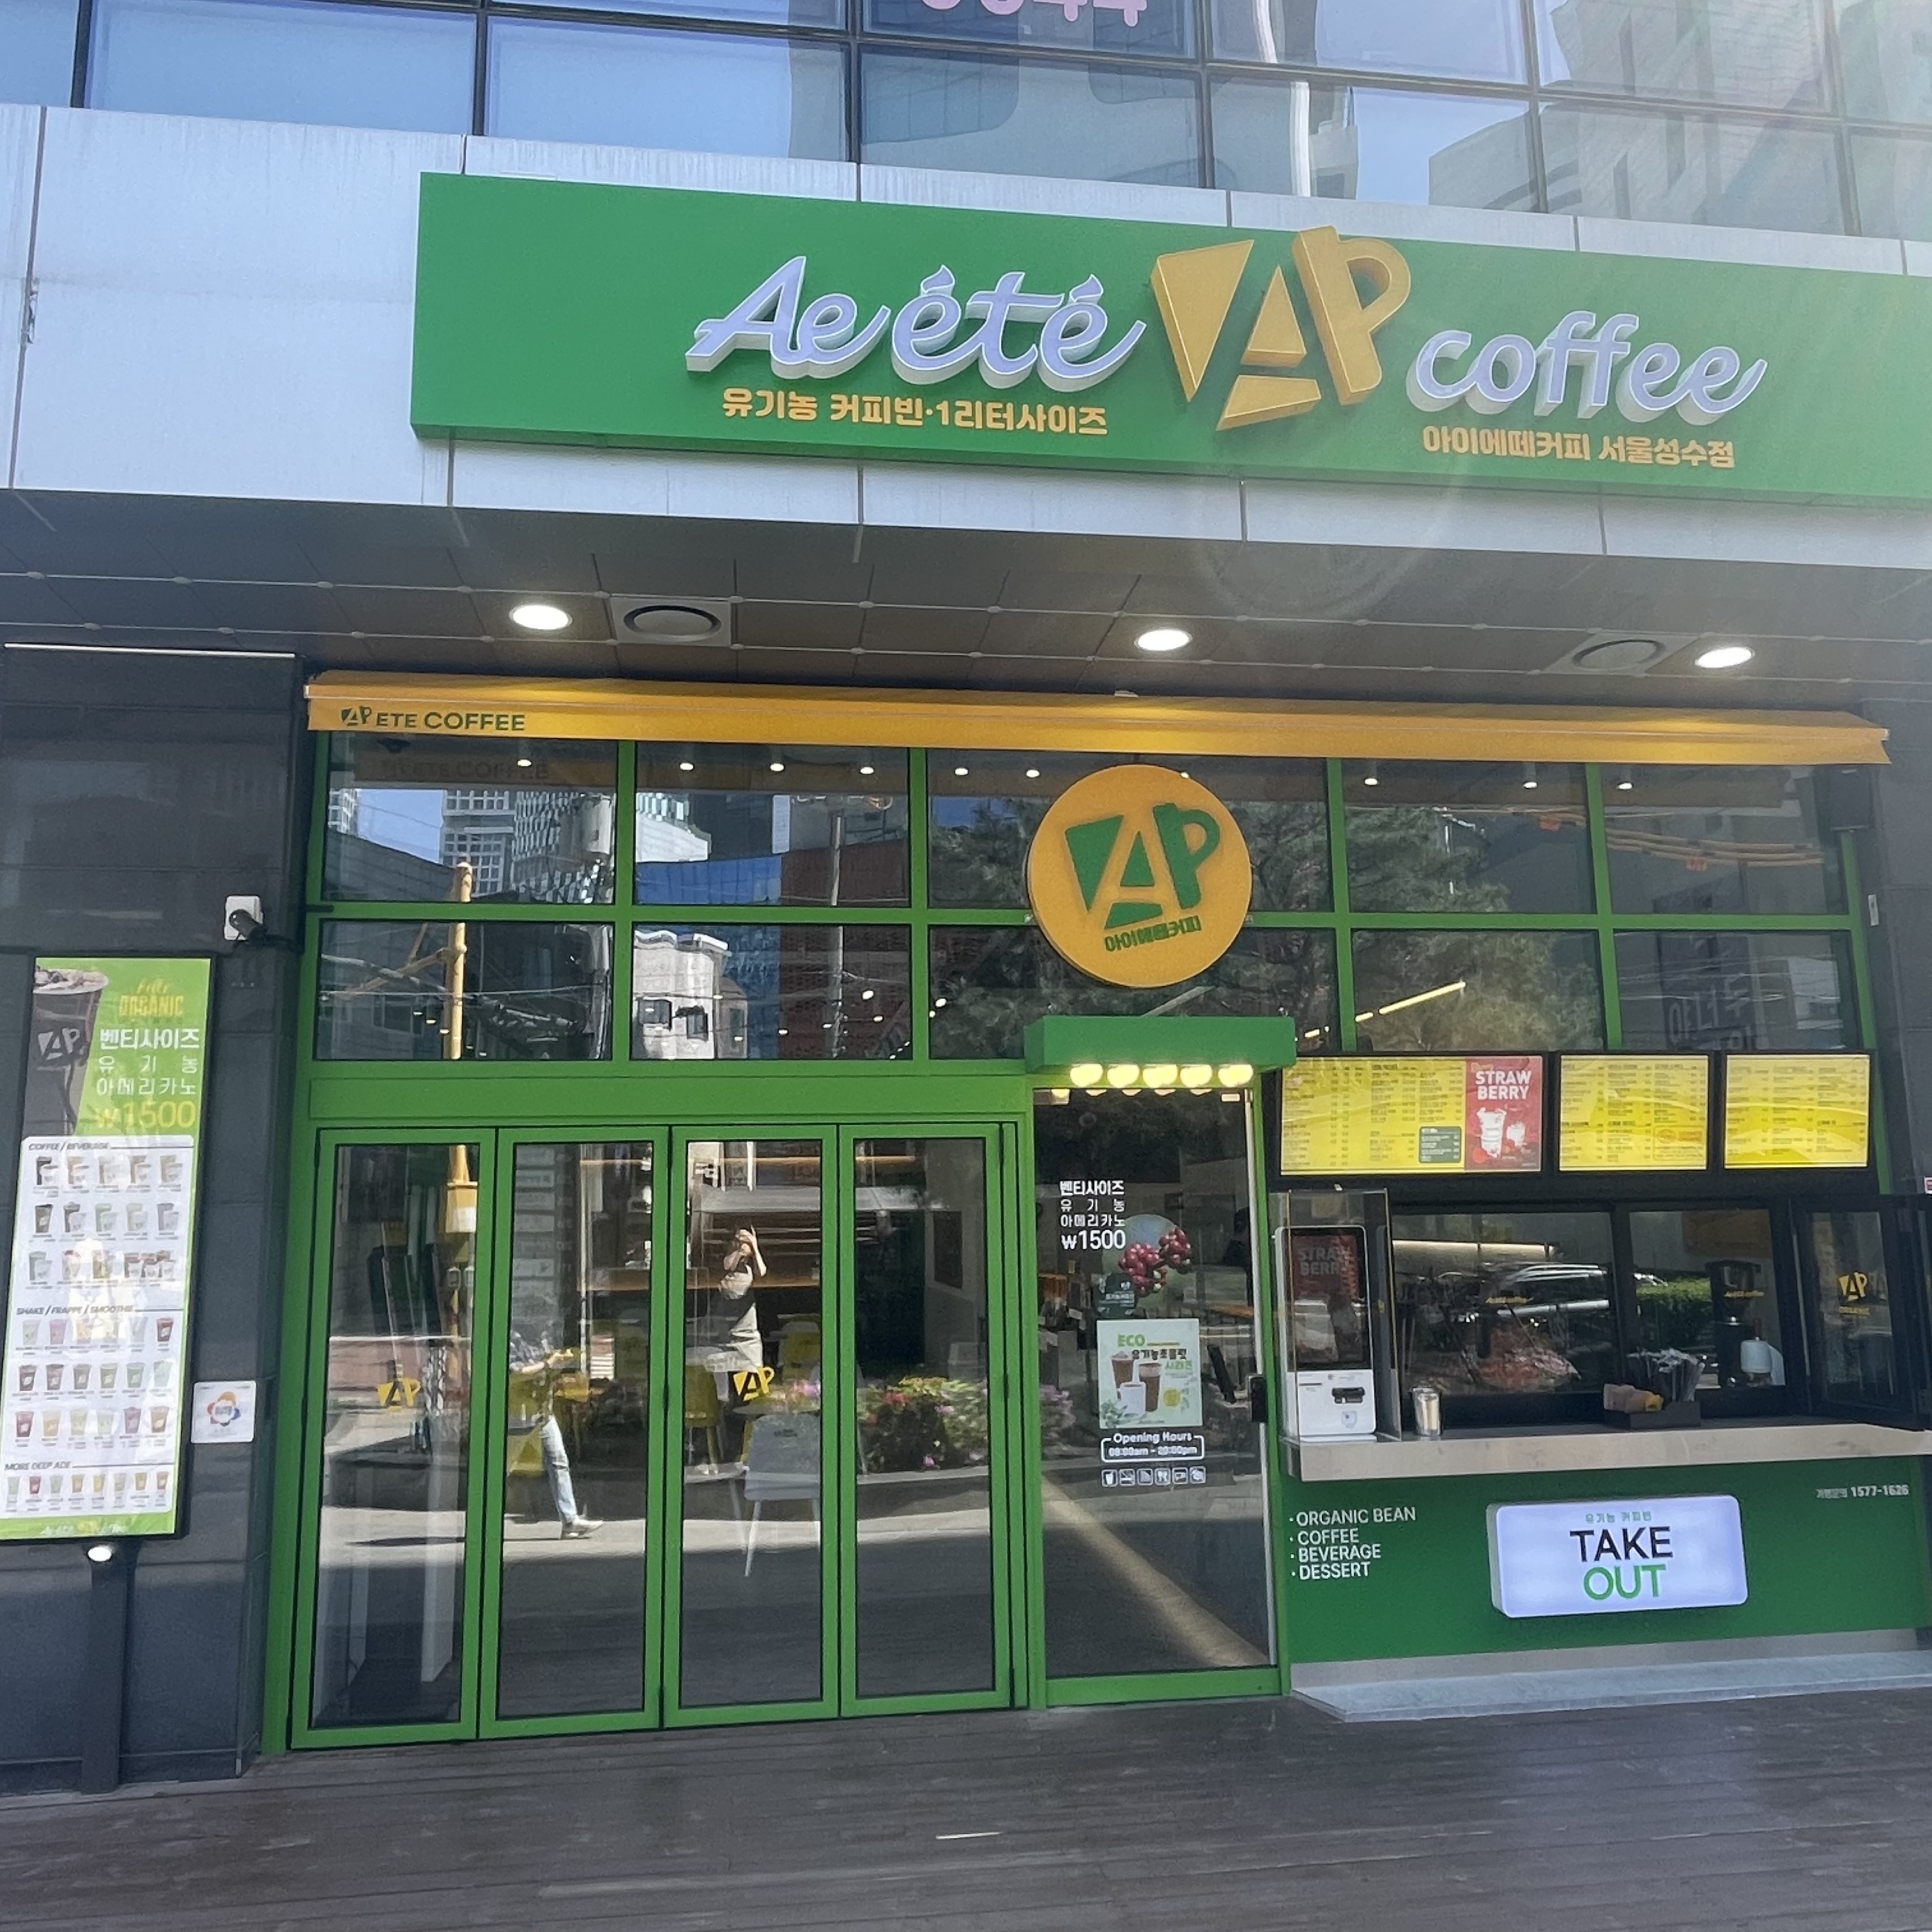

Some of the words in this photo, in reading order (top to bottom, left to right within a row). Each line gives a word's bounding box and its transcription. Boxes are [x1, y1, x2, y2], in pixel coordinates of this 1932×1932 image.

[1406, 310, 1767, 425] coffee
[723, 388, 818, 421] 유기농
[1423, 426, 1590, 461] 아이에떼커피
[1598, 437, 1736, 468] 서울성수점
[376, 712, 417, 728] ETE
[425, 712, 525, 730] COFFEE
[119, 995, 184, 1016] ORGANIC
[100, 1028, 200, 1050] 벤티사이즈
[1475, 1070, 1531, 1085] STRAW
[1478, 1085, 1529, 1100] BERRY
[1059, 1180, 1124, 1196] 벤티사이즈
[1117, 1334, 1146, 1347] ECO
[1296, 1509, 1368, 1526] ORGANIC
[1373, 1506, 1416, 1523] BEAN
[1297, 1528, 1360, 1545] COFFEE
[1569, 1526, 1673, 1562] TAKE
[1298, 1544, 1381, 1563] BEVERAGE
[1300, 1561, 1371, 1580] DESSERT
[1583, 1564, 1666, 1601] OUT
